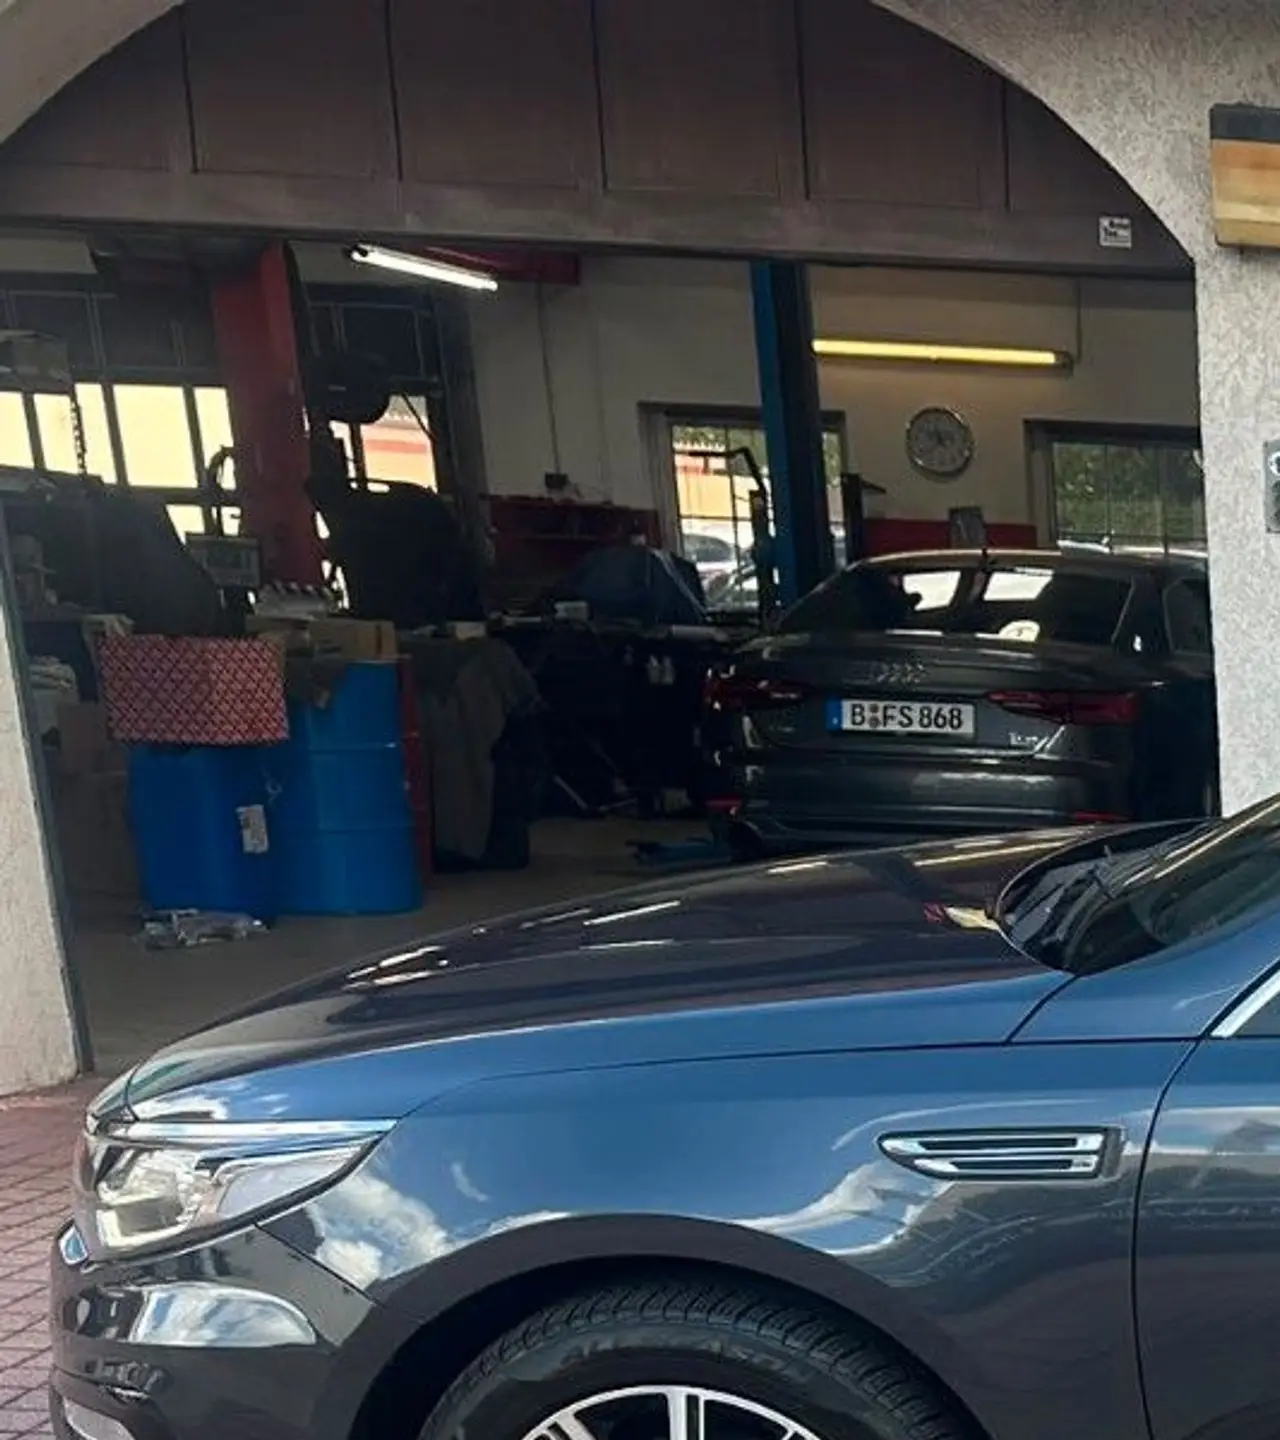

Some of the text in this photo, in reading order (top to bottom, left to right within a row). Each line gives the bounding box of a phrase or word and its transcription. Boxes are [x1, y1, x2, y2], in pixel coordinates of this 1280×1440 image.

[850, 702, 963, 731] B FS 868
